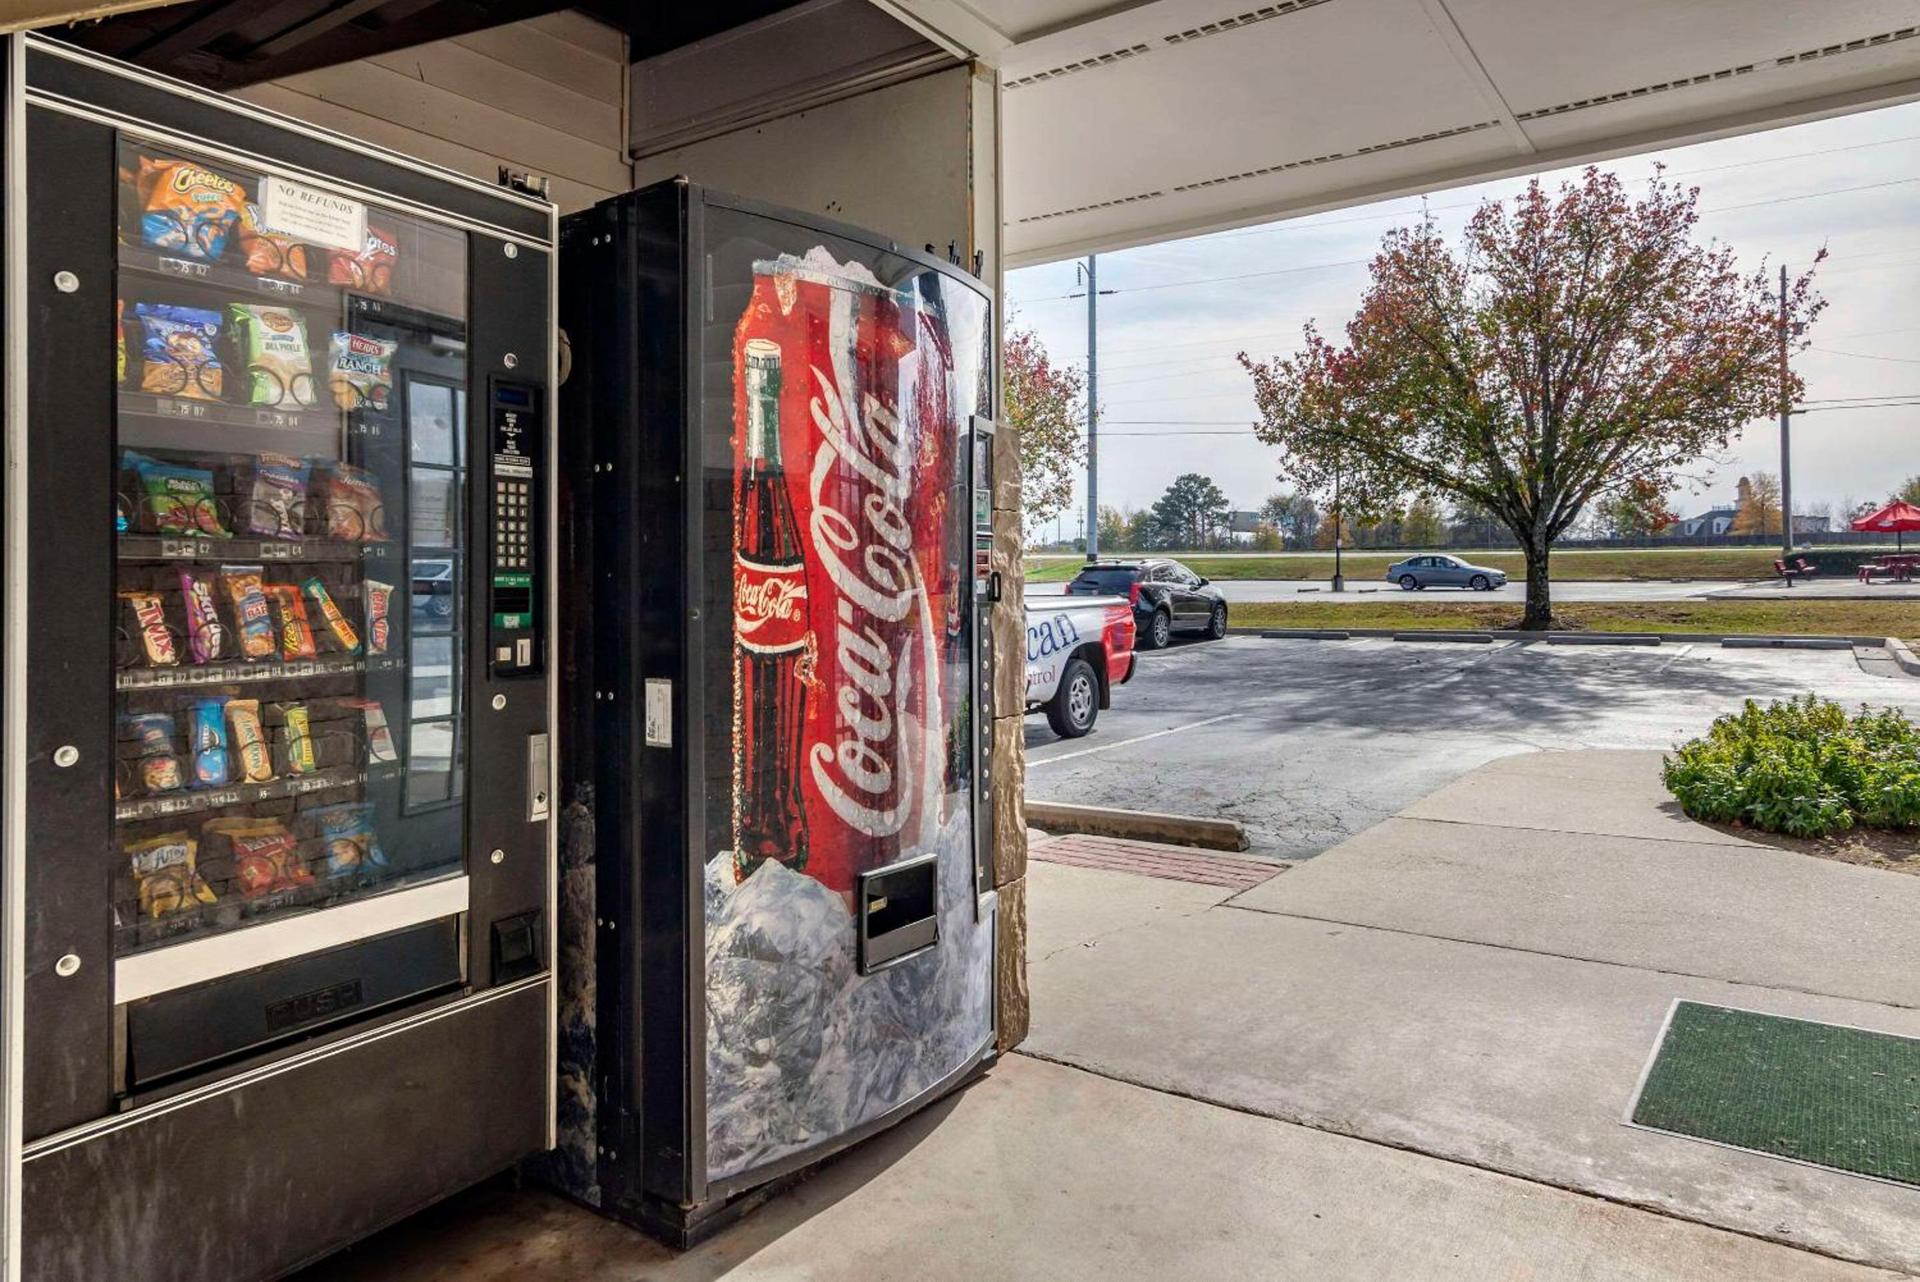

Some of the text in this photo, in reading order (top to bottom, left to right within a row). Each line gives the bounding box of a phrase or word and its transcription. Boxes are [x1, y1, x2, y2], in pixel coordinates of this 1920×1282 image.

[279, 184, 296, 197] NO
[300, 191, 354, 215] REFUNDS
[337, 356, 382, 376] RANCH
[739, 572, 794, 619] Coca-Cola
[809, 364, 922, 838] Coca-Cola
